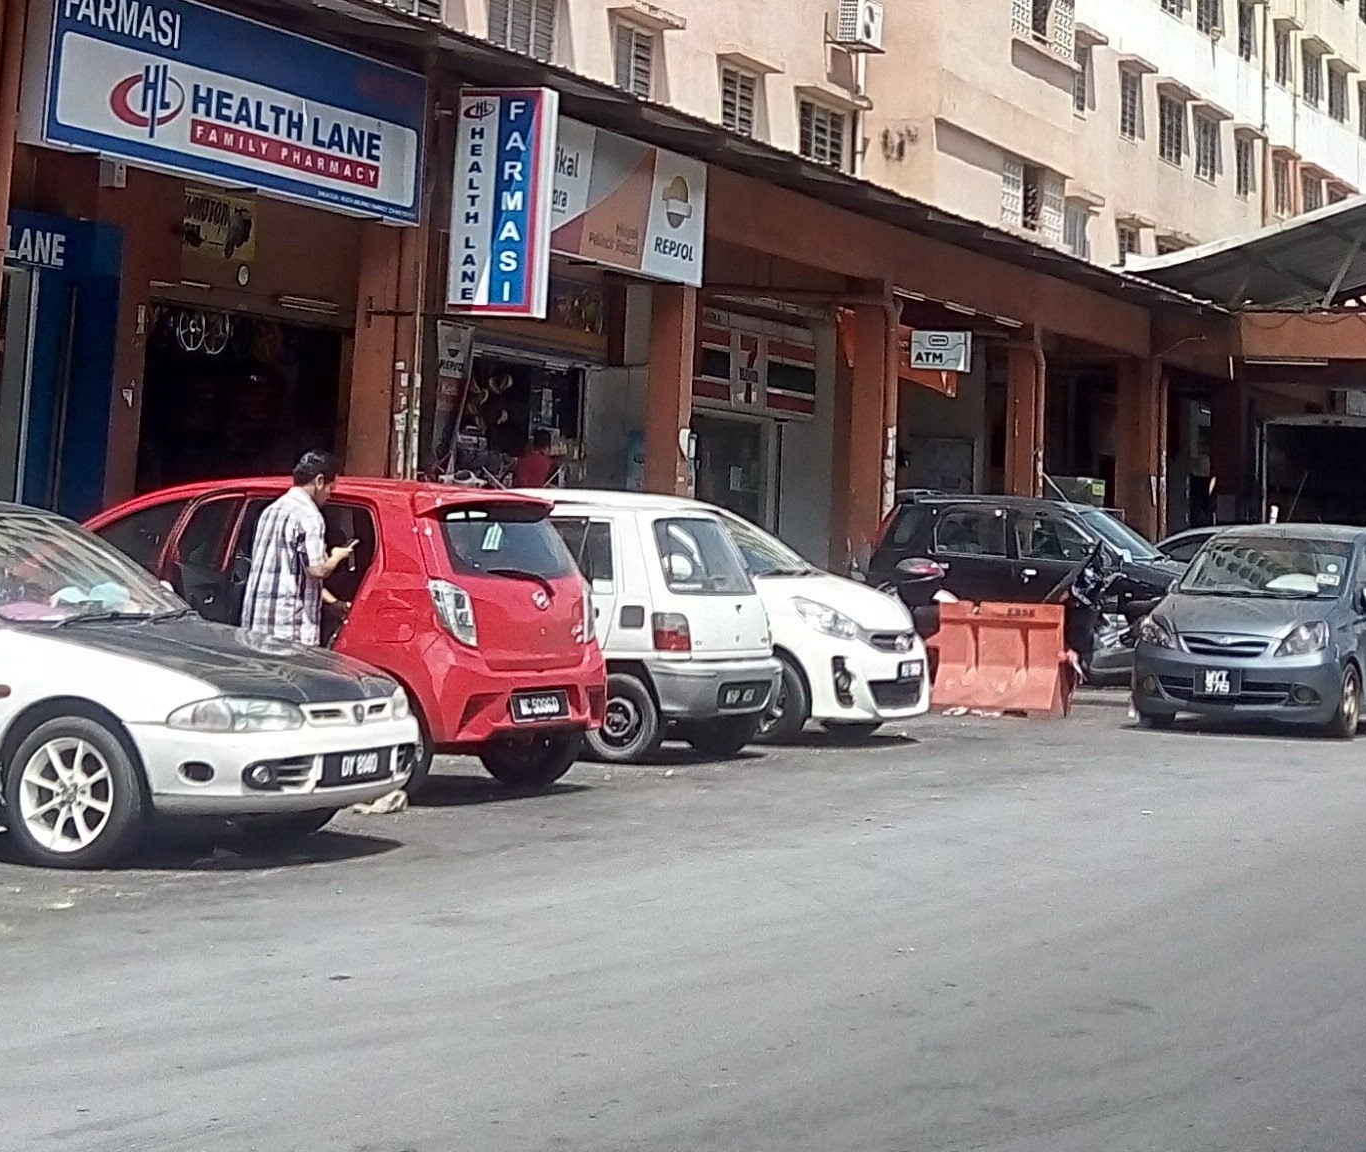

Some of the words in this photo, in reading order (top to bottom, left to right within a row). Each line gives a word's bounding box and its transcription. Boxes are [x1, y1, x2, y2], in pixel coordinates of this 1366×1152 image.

[193, 83, 304, 142] HEALTH
[312, 121, 382, 162] LANE
[196, 124, 269, 157] FAMILY
[281, 147, 378, 184] PHARMACY
[465, 127, 485, 225] HEALTH
[499, 101, 527, 302] FARMASI
[4, 224, 66, 267] LANE
[460, 237, 477, 301] LANE
[654, 236, 695, 262] REPSOL
[915, 352, 943, 363] ATM
